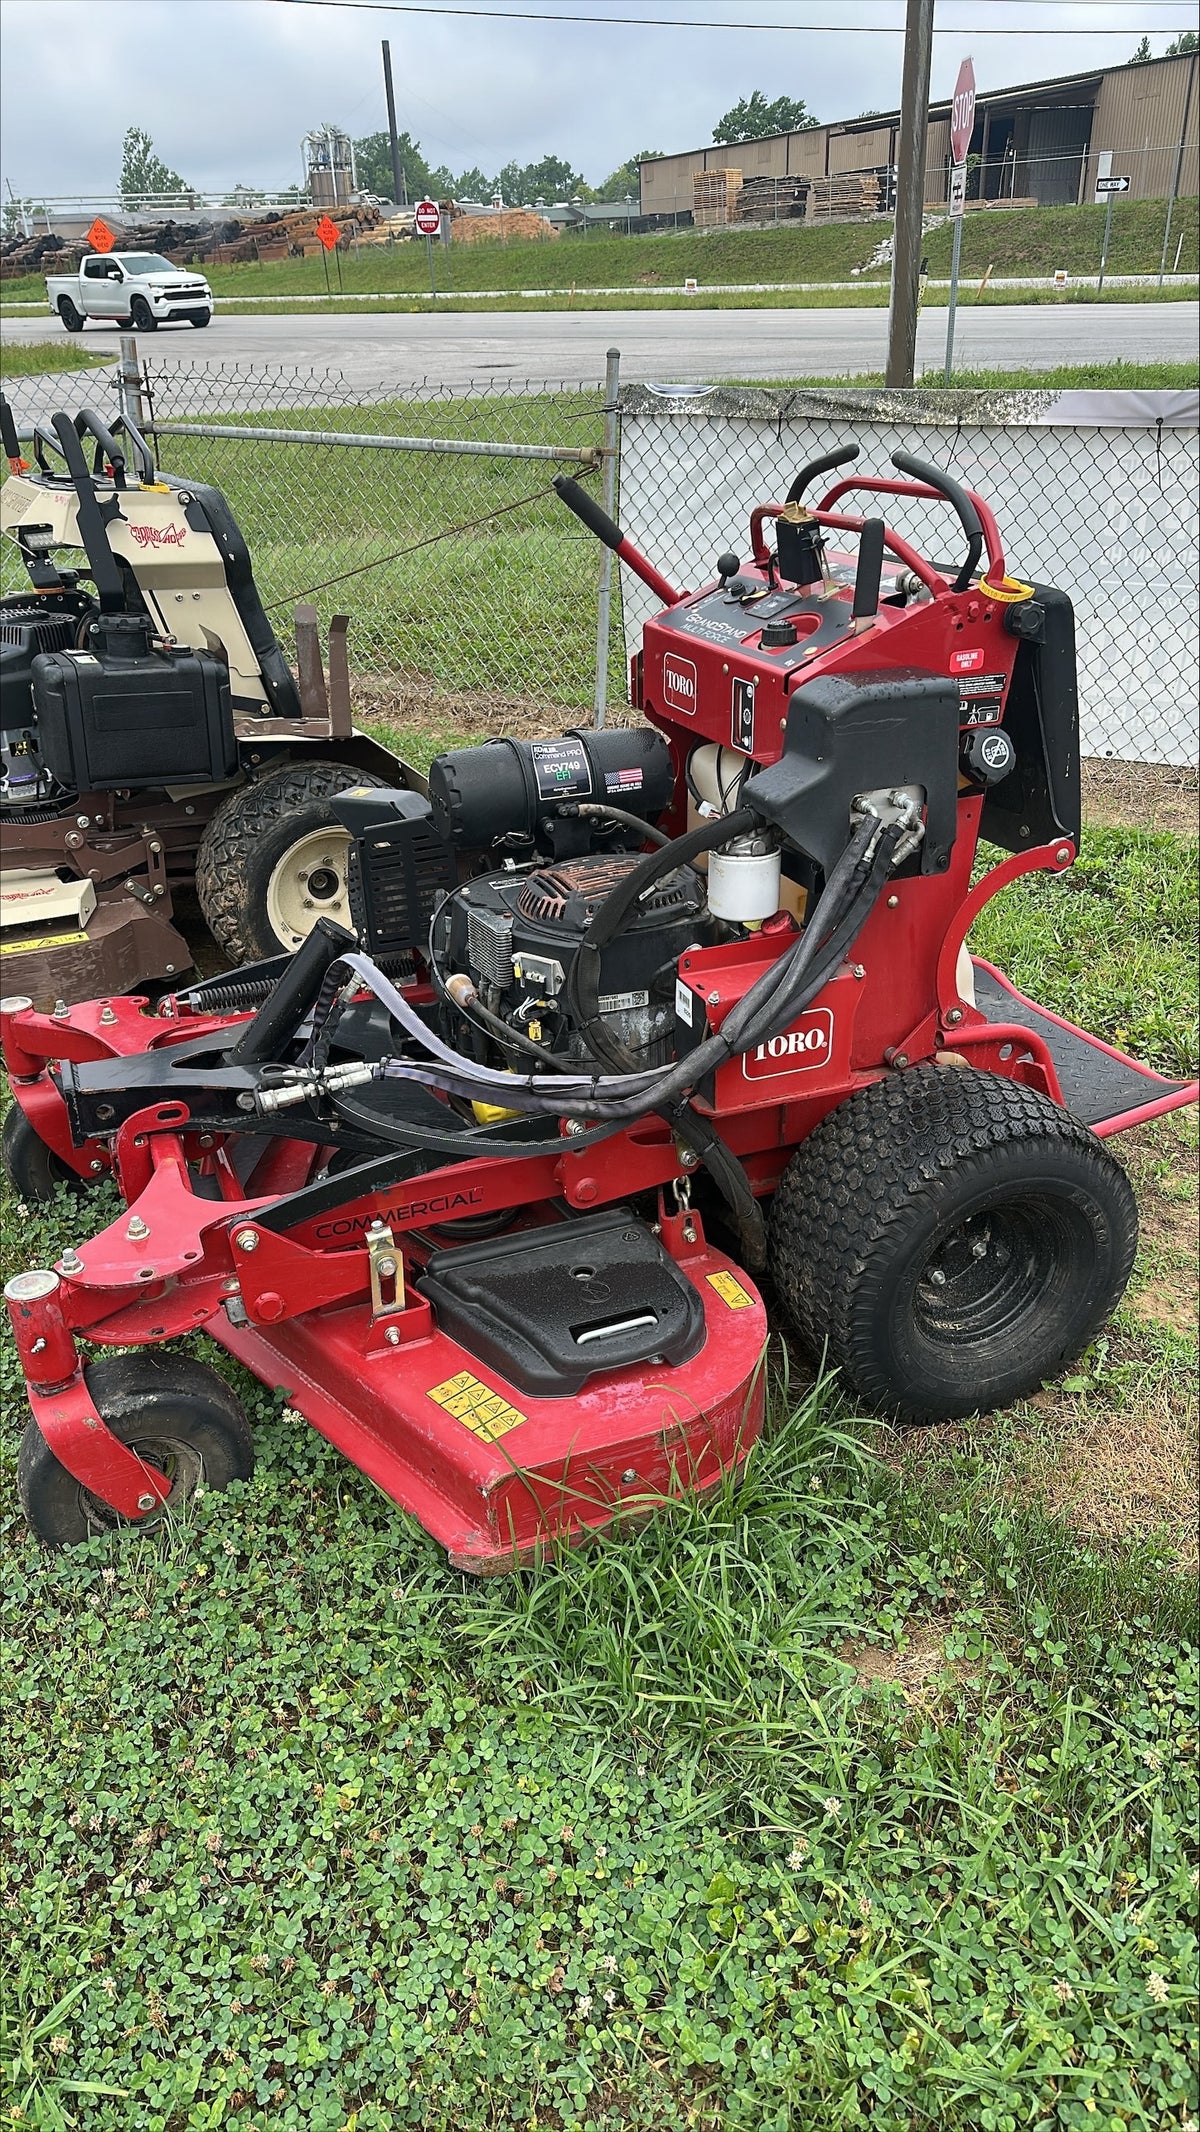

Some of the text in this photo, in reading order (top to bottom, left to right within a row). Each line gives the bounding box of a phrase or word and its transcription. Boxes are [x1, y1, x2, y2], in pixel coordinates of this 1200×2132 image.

[953, 89, 974, 133] STOP
[1099, 181, 1121, 189] ONE WAY
[680, 623, 733, 644] MULTI FORCE
[956, 651, 979, 662] GASOLINE
[960, 660, 973, 669] ONLY
[666, 669, 693, 697] TORO
[534, 748, 582, 760] Command PRO
[543, 760, 581, 774] ECV749
[556, 770, 571, 781] EFI
[315, 1190, 483, 1240] COMMERCIAL
